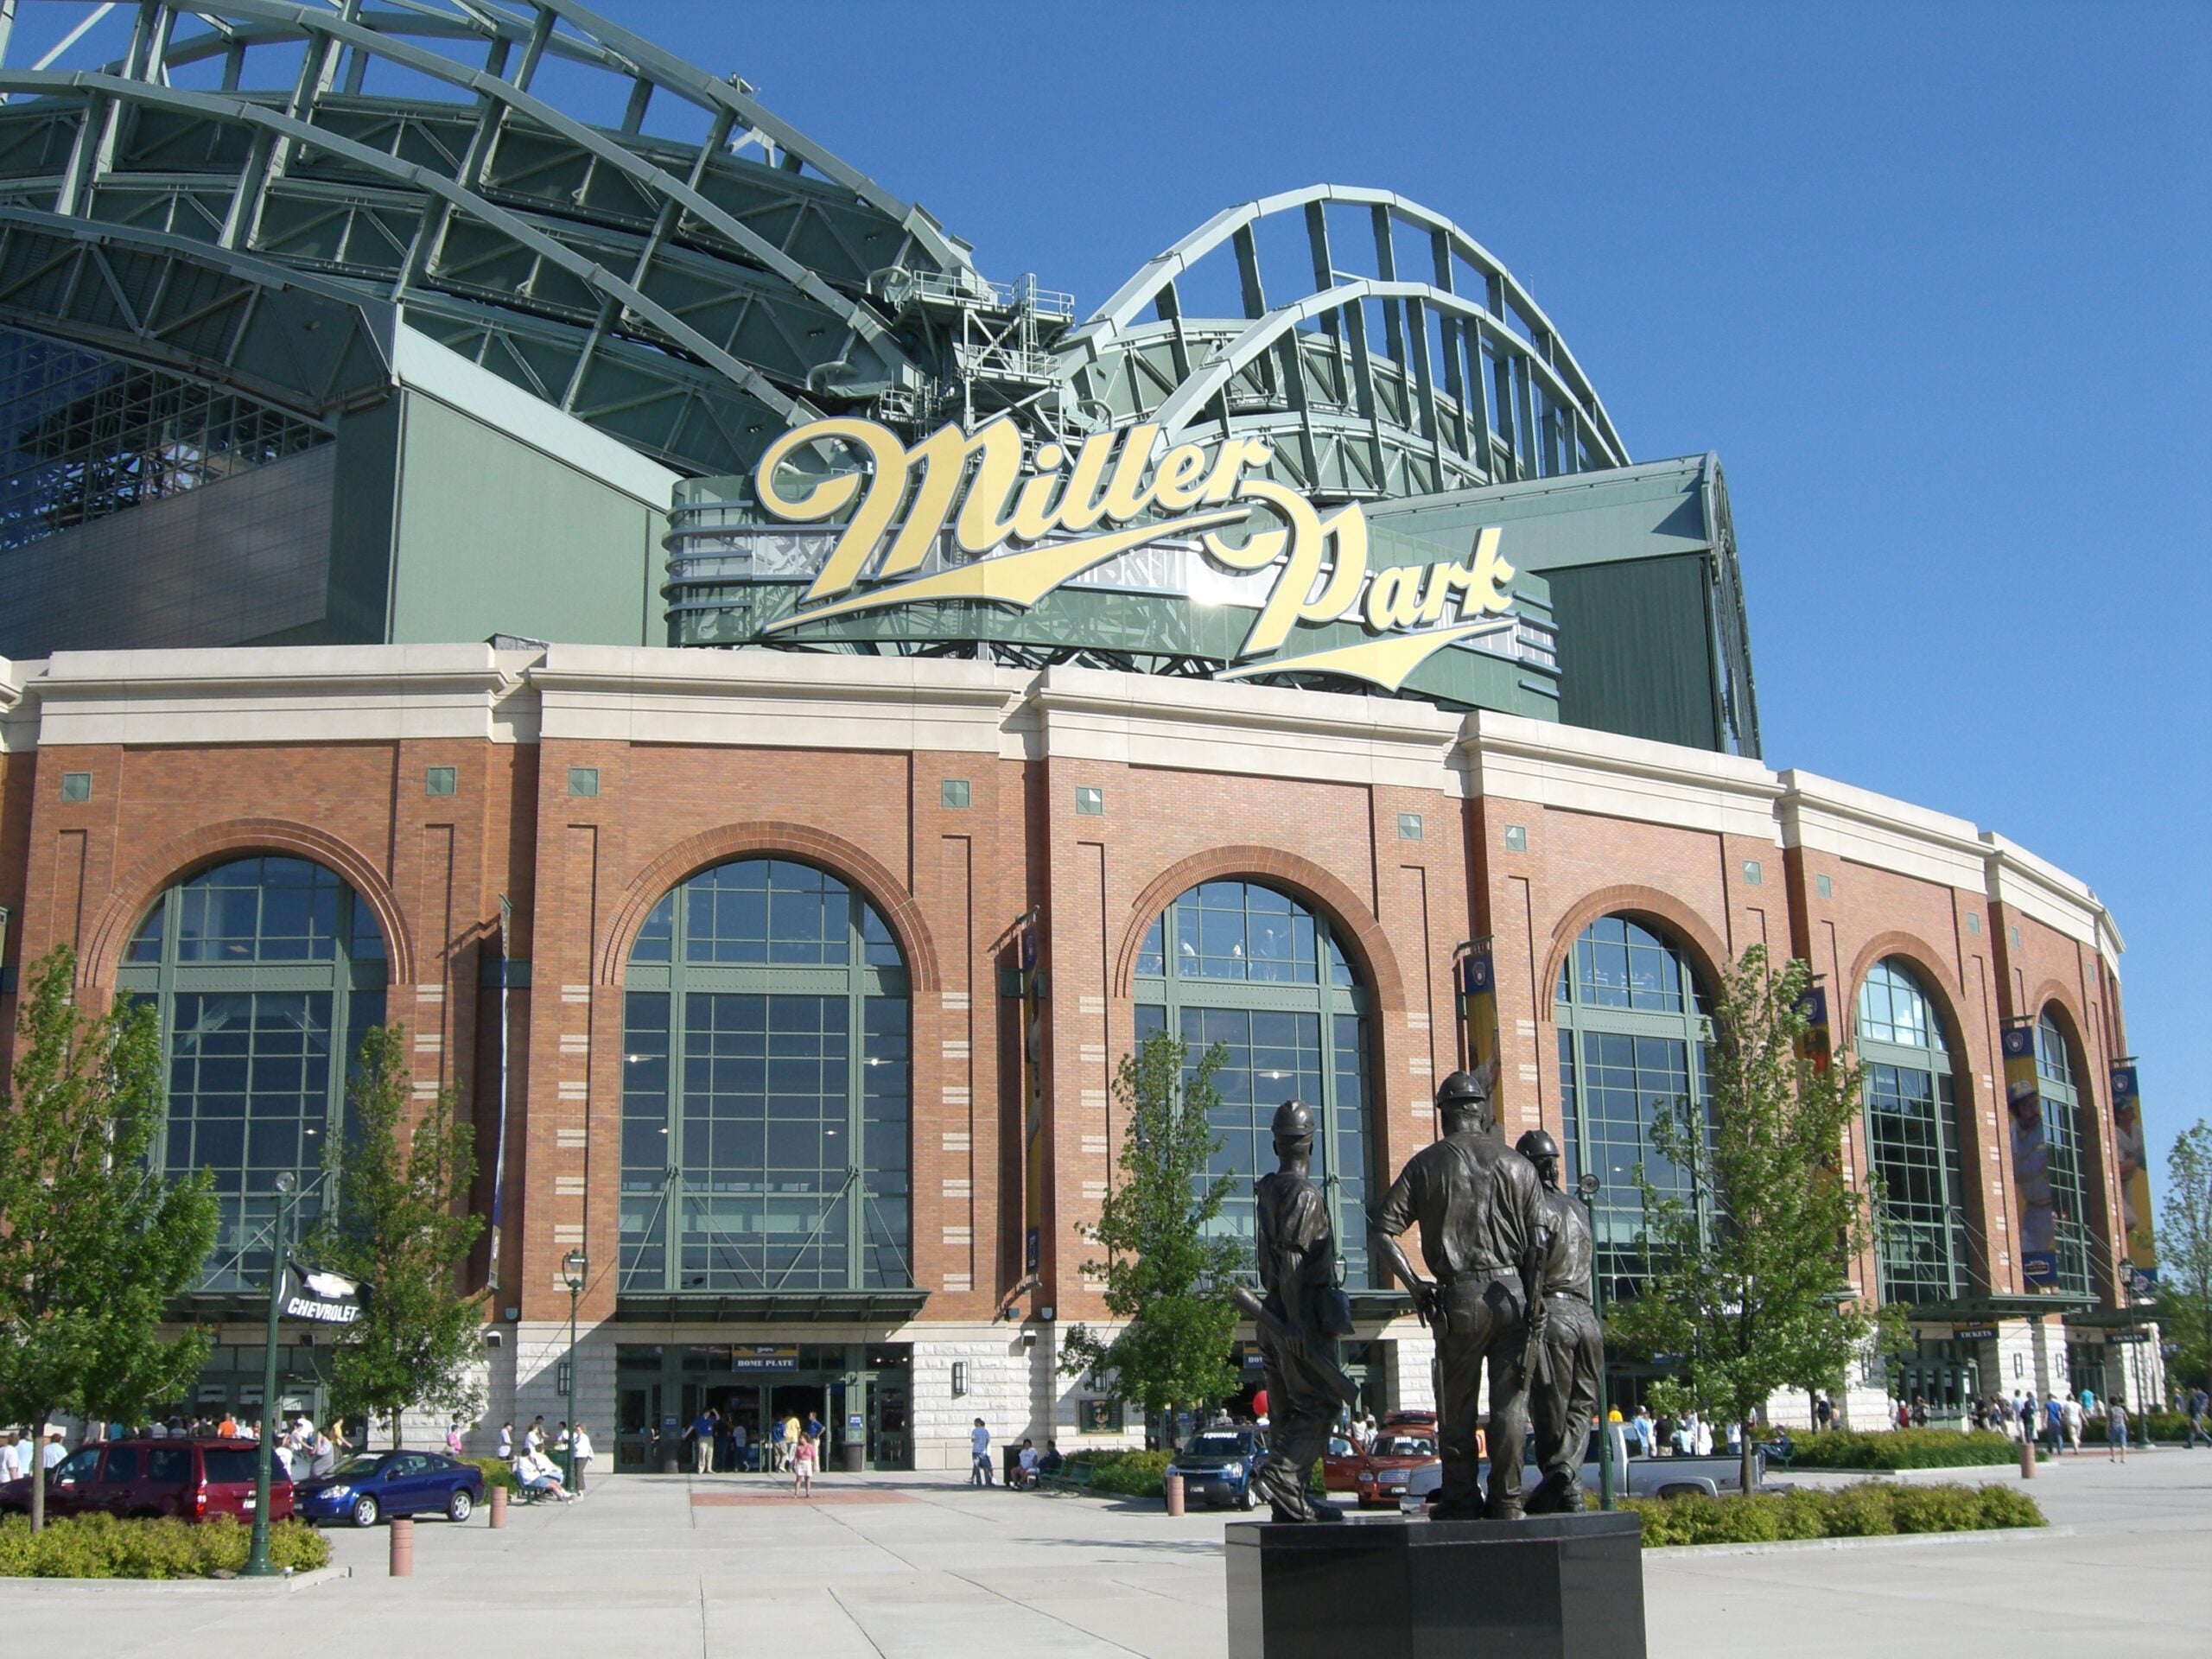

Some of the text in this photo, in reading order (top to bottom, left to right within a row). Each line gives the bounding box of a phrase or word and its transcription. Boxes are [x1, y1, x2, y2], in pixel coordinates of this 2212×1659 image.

[755, 416, 1515, 657] Miller Park
[287, 1297, 359, 1322] CHEVROLET
